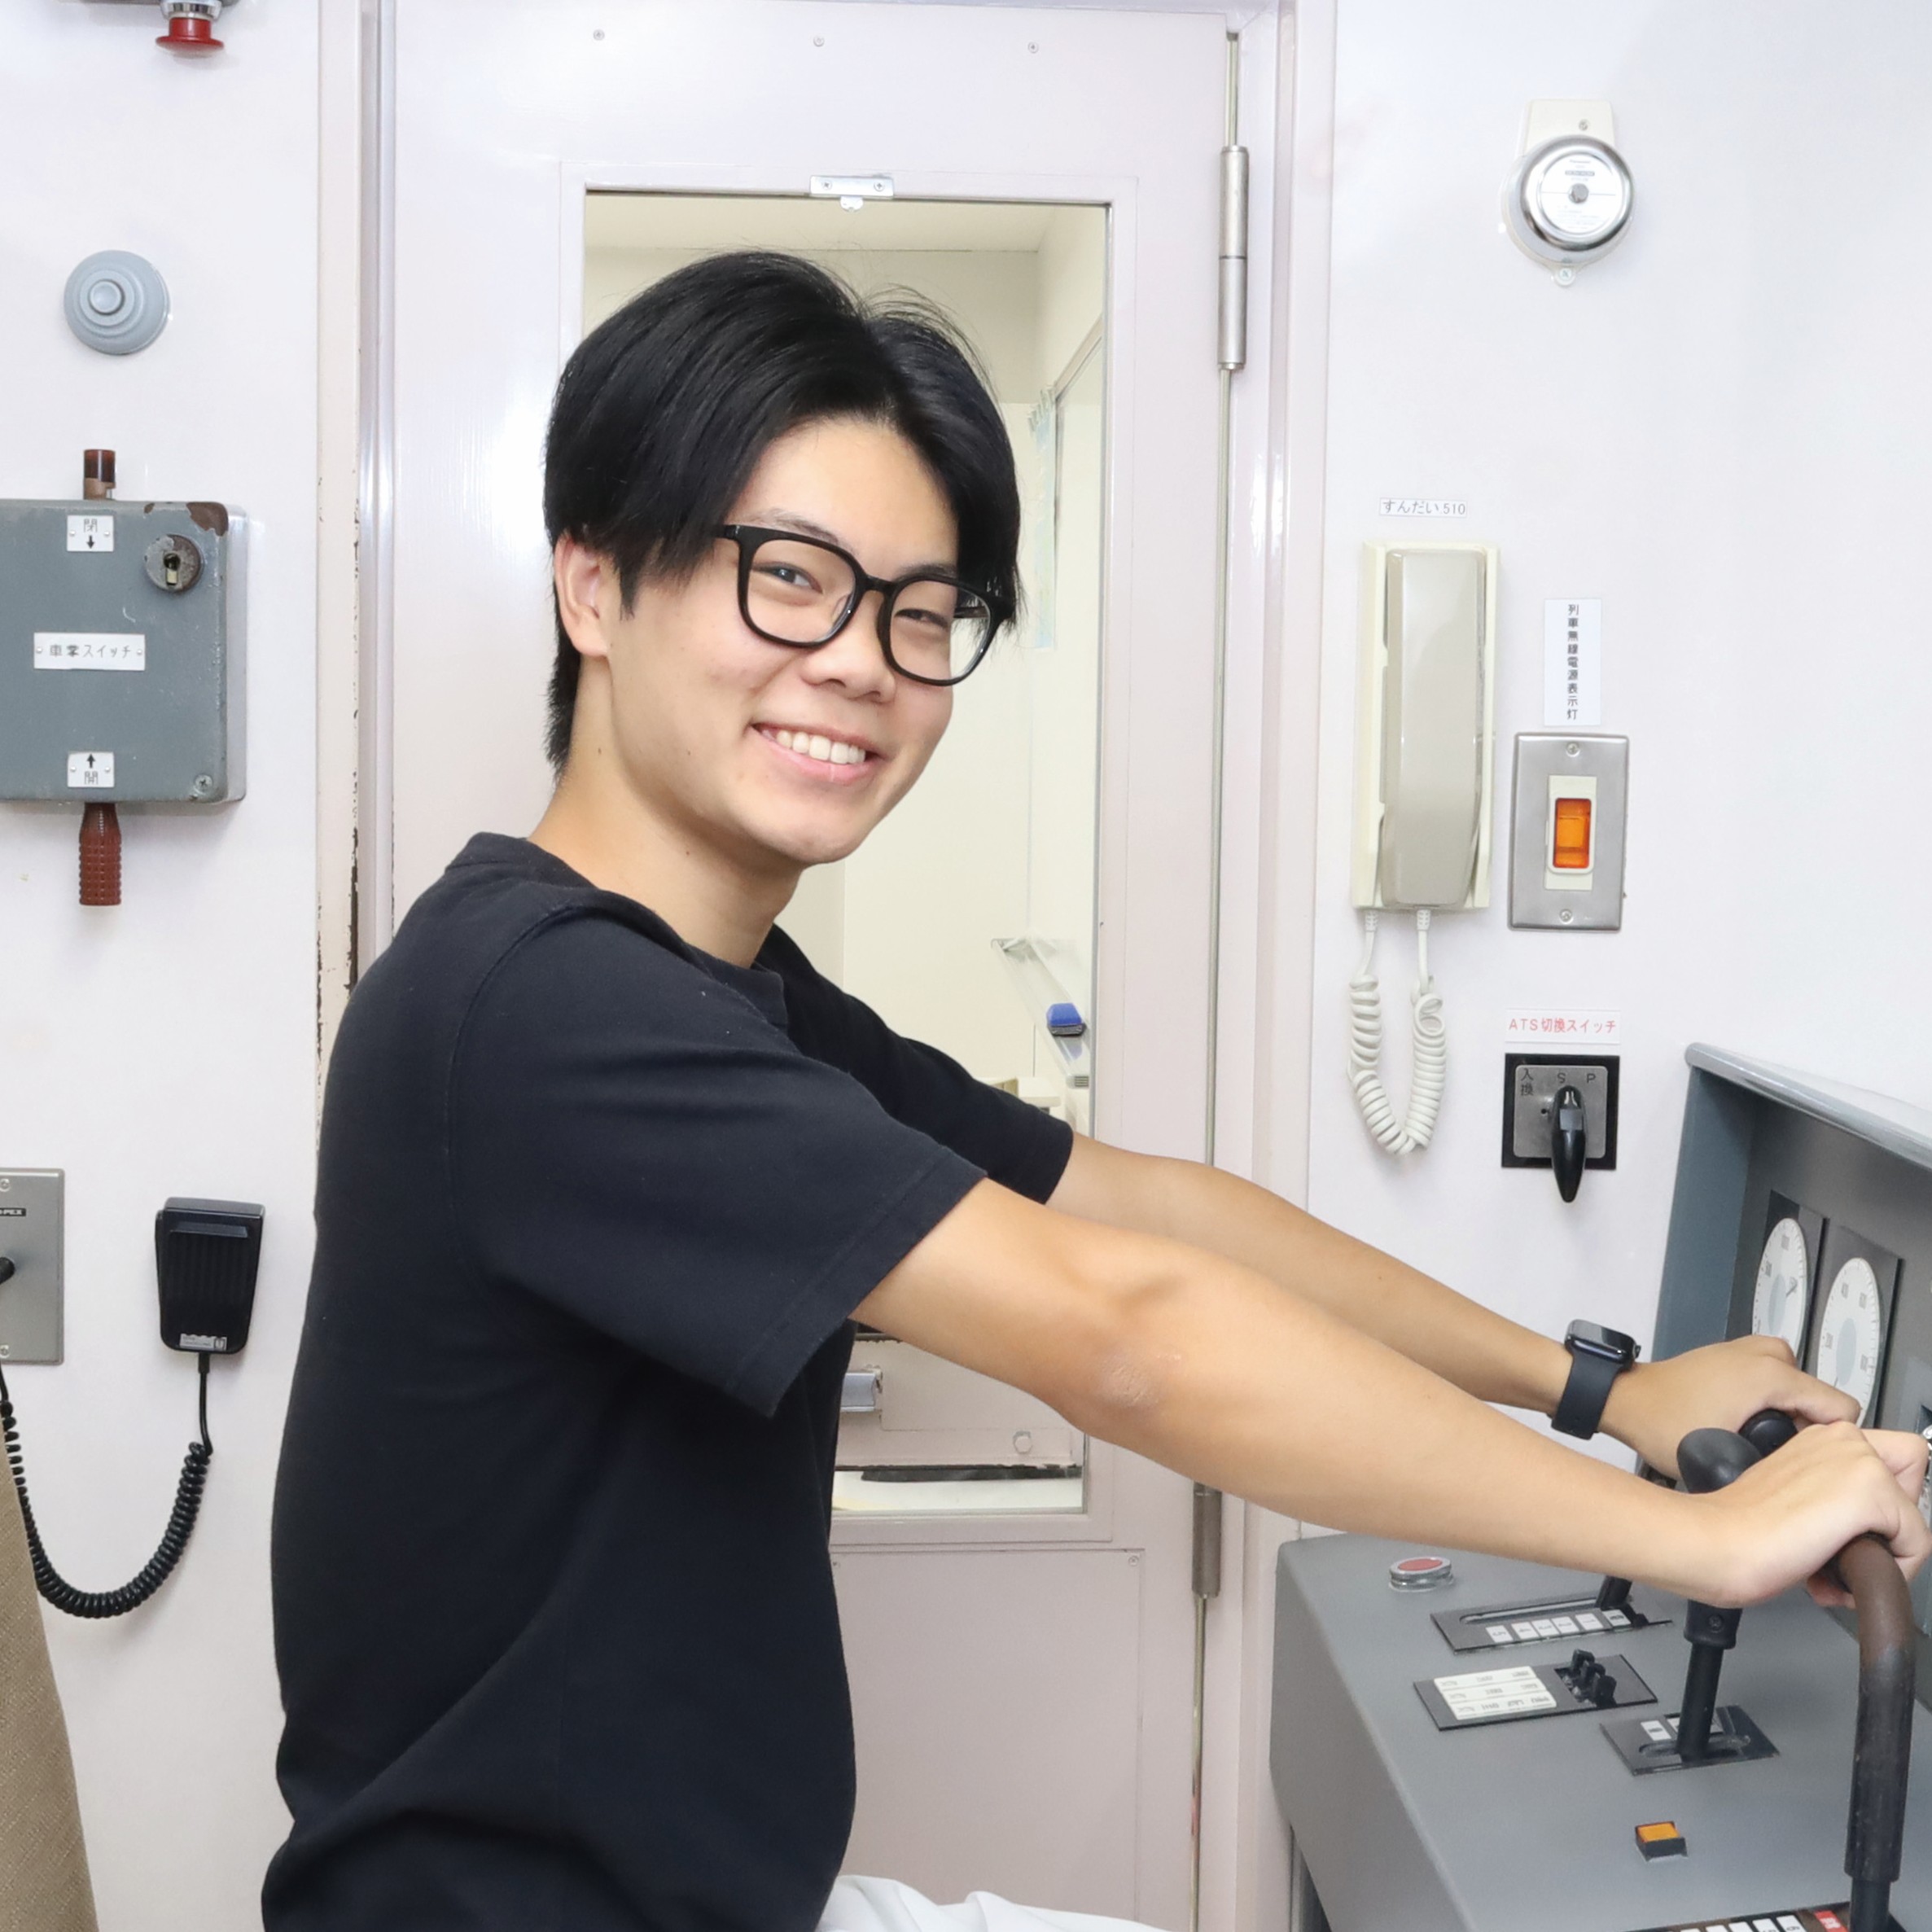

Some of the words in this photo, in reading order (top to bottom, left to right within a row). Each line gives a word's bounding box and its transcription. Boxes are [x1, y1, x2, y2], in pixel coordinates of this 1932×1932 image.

[1567, 604, 1579, 720] 列車無線電源表示灯
[84, 770, 99, 785] 開
[1509, 1018, 1616, 1033] ATS切換スイッチ
[1557, 1072, 1566, 1084] S
[1586, 1073, 1597, 1084] P
